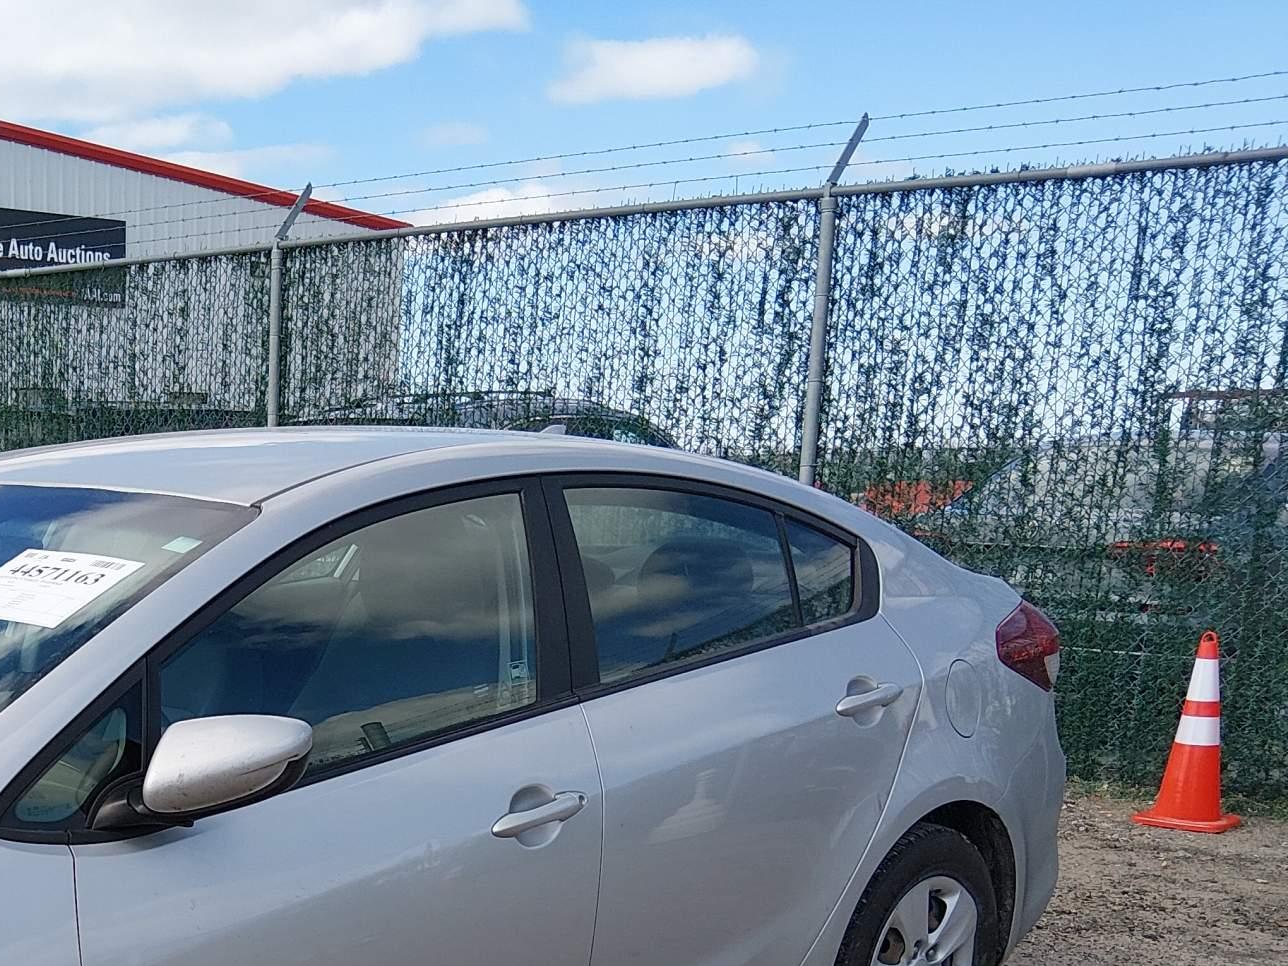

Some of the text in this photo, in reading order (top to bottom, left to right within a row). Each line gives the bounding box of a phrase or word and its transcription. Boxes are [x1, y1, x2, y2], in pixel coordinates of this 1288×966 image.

[8, 238, 43, 261] Auto
[47, 242, 111, 264] Auctions
[9, 563, 106, 585] 44571163
